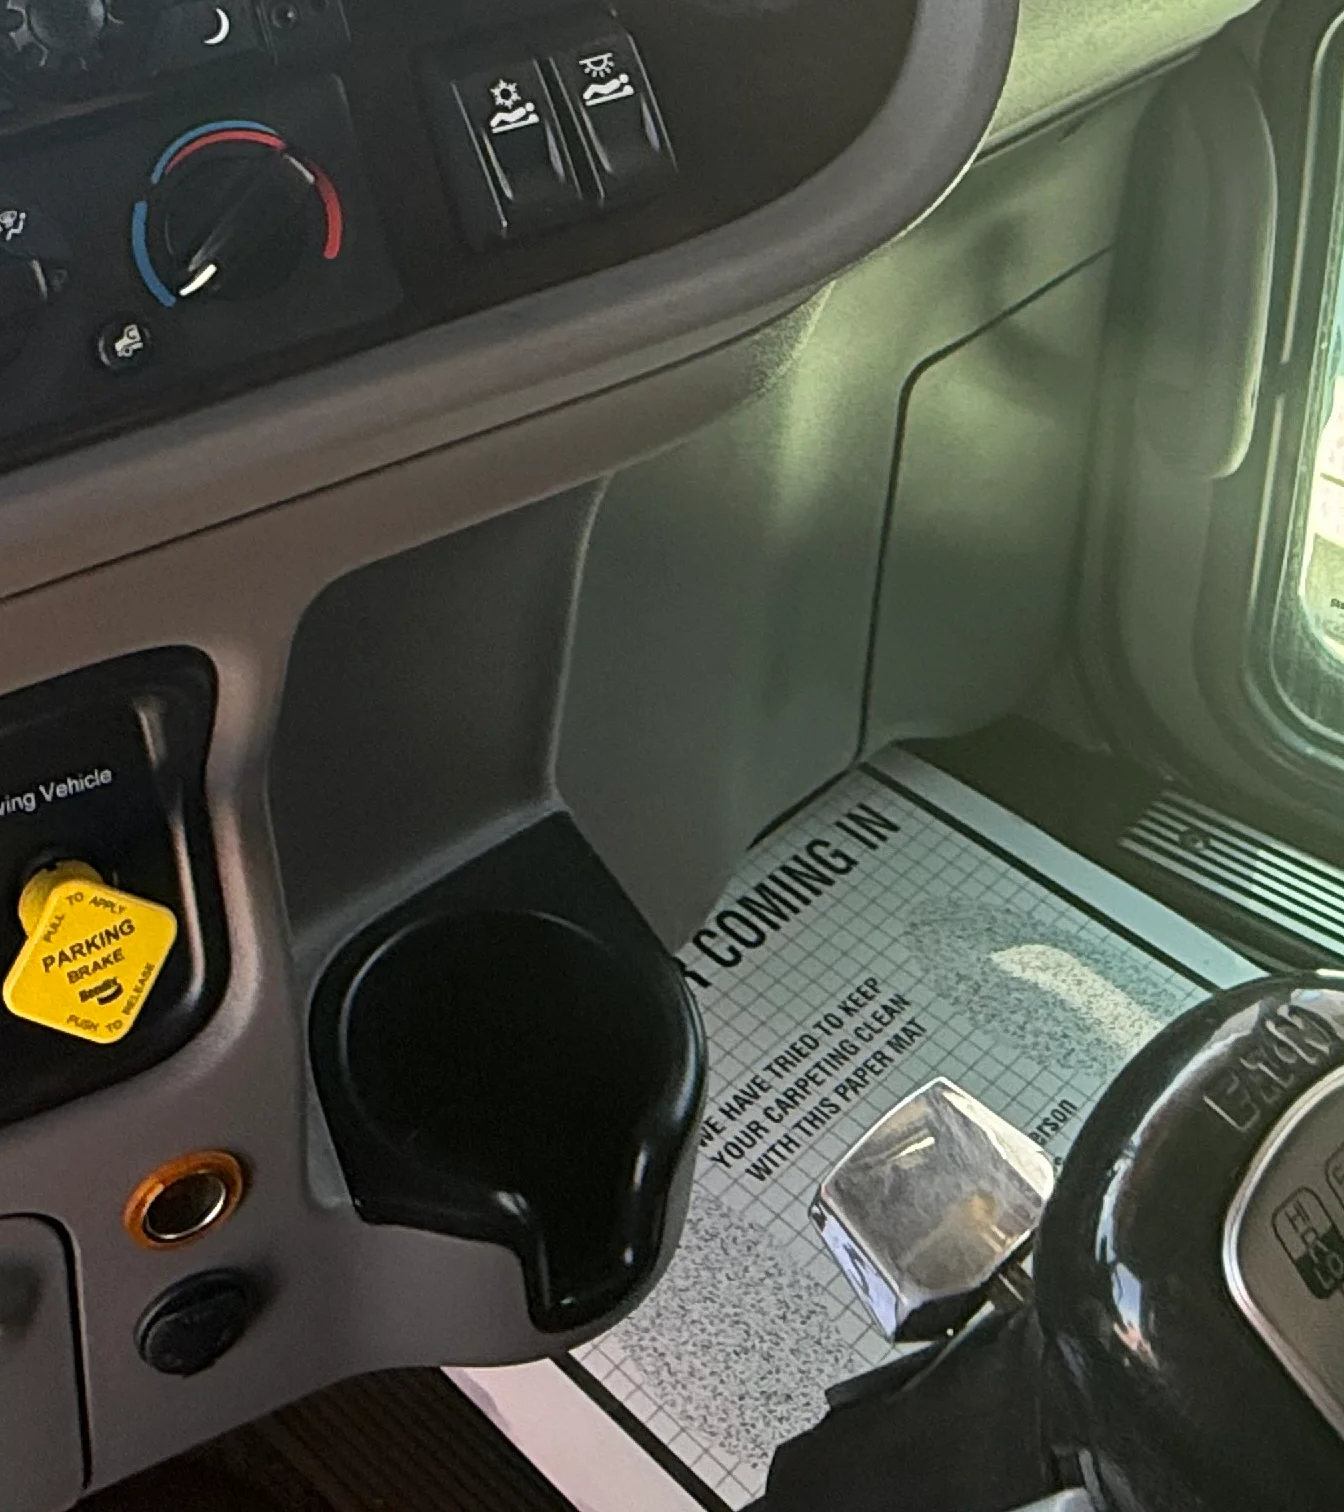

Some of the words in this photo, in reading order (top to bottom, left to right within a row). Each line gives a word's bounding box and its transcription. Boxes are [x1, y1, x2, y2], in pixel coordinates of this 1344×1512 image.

[39, 766, 113, 803] Vehicle
[693, 838, 859, 968] COMING
[837, 802, 901, 851] IN
[43, 913, 65, 944] PULL
[65, 891, 85, 906] TO
[88, 895, 127, 915] APPLY
[41, 918, 136, 973] PARKING
[66, 947, 125, 984] BRAKE
[66, 1014, 100, 1033] PUSH
[105, 1019, 123, 1033] TO
[121, 962, 156, 1016] RELEASE
[718, 1075, 772, 1121] HAVE
[763, 1032, 820, 1079] TRIED
[817, 1011, 844, 1042] TO
[838, 977, 881, 1024] KEEP
[711, 1120, 769, 1169] YOUR
[762, 1037, 860, 1124] CARPETING
[856, 993, 912, 1044] CLEAN
[744, 1133, 801, 1181] WITH
[792, 1096, 841, 1137] THIS
[833, 1050, 893, 1102] PAPER
[890, 1016, 930, 1055] MAT
[1284, 1200, 1311, 1232] HI
[1314, 1251, 1344, 1290] LO
